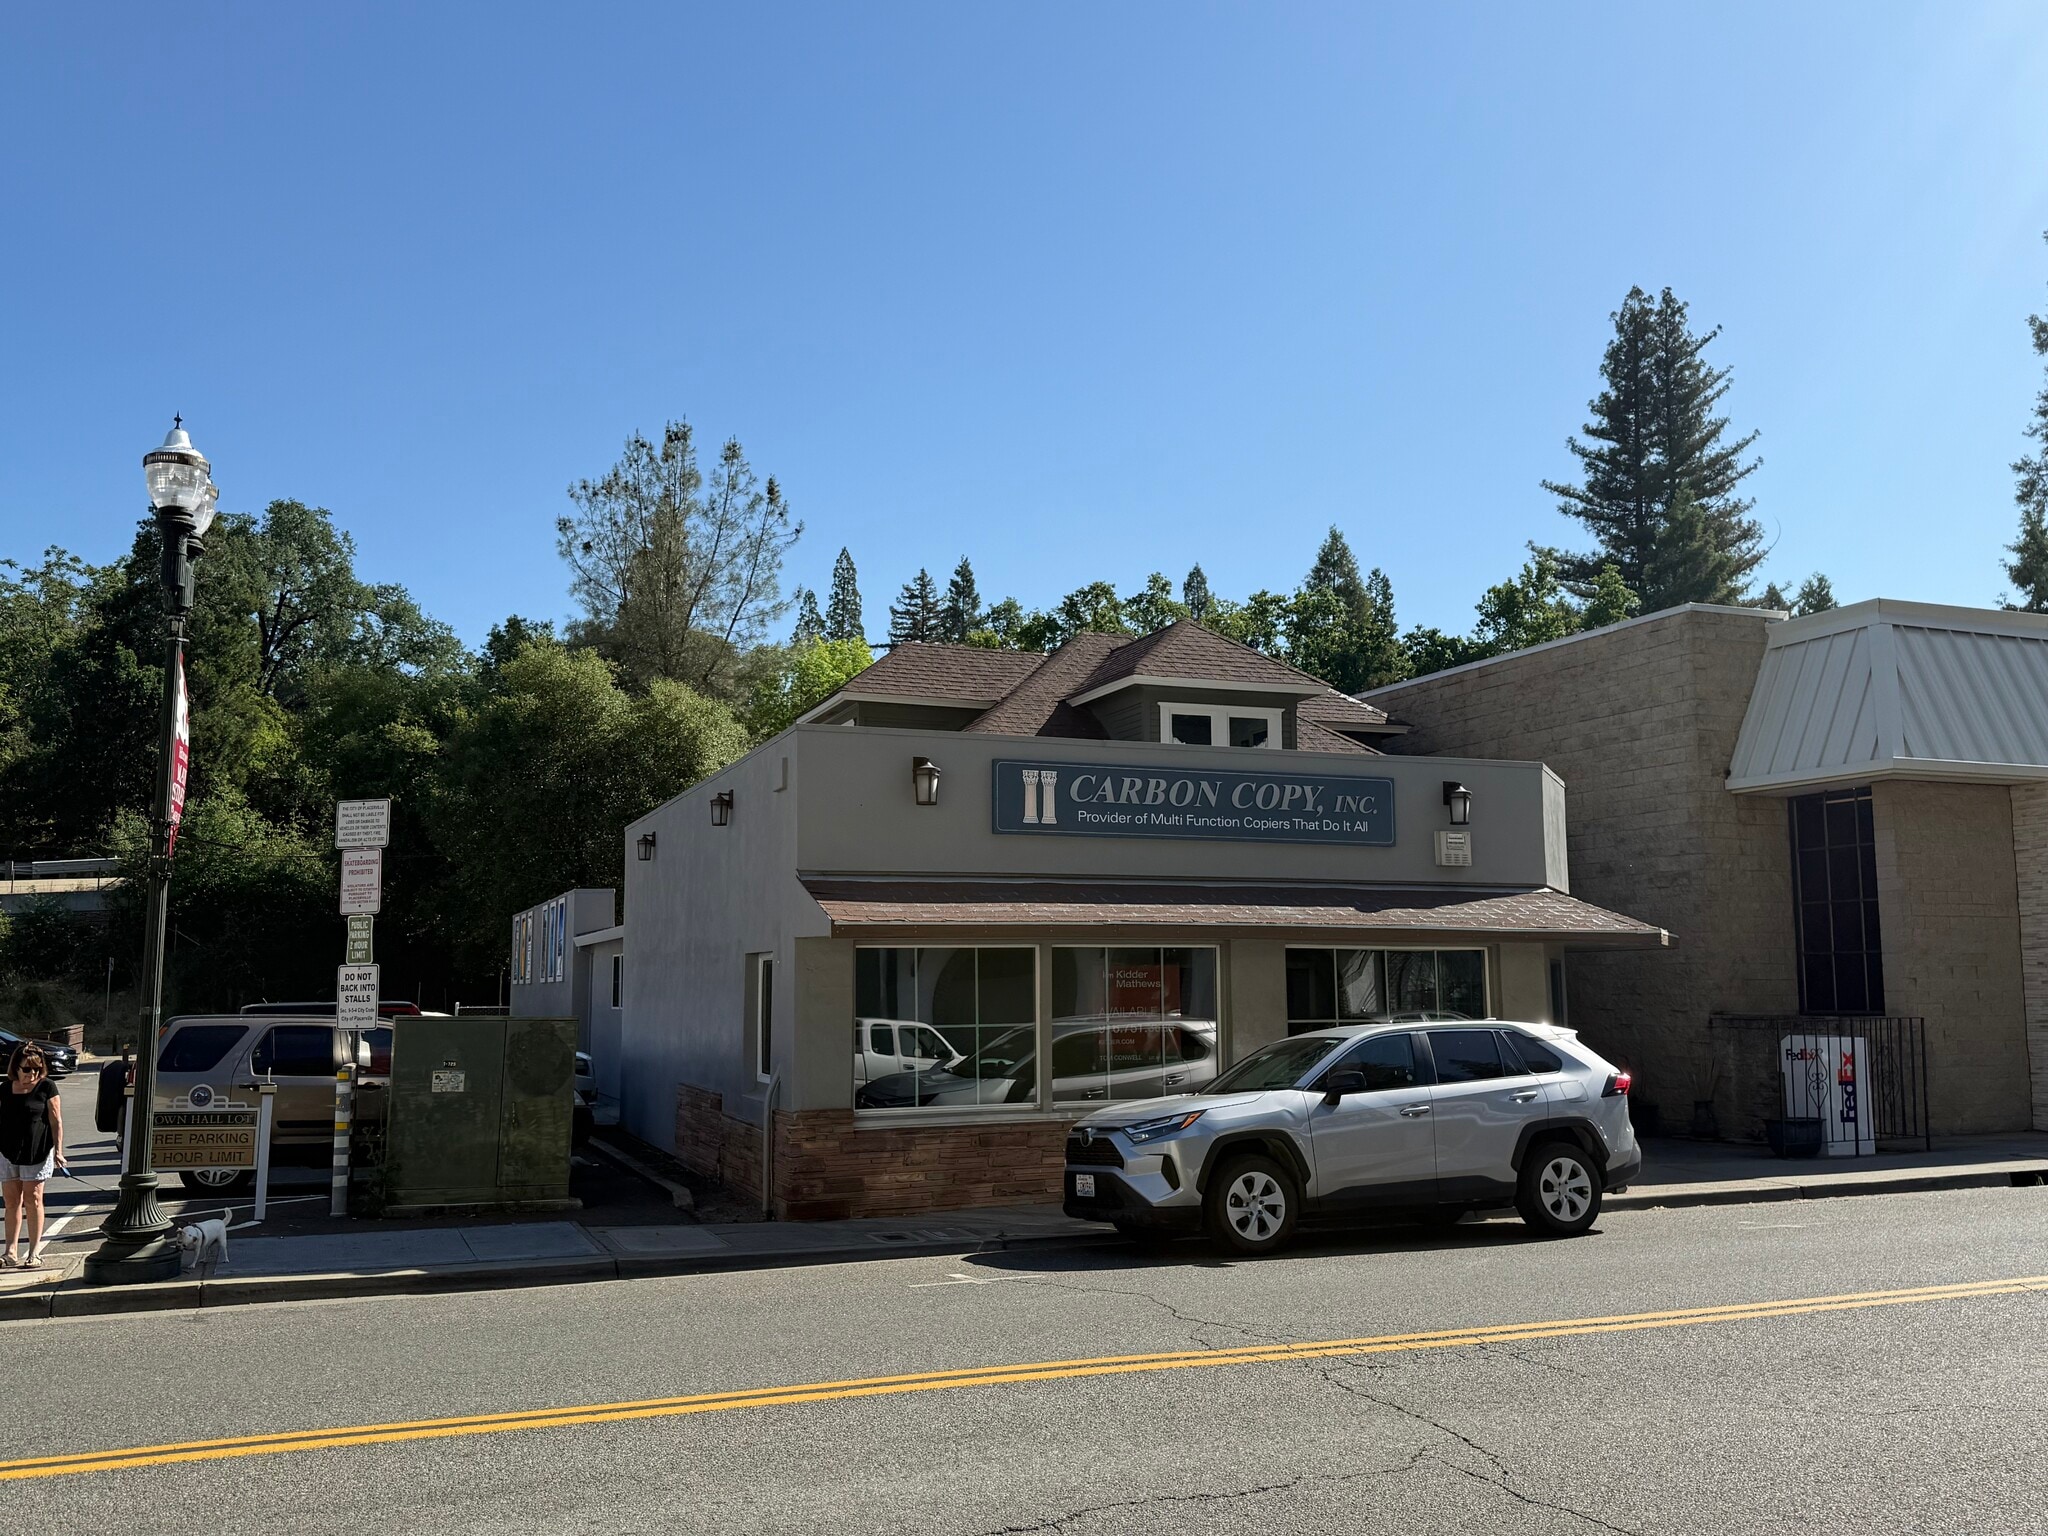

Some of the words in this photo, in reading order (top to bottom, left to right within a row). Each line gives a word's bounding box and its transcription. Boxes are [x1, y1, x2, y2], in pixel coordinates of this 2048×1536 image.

[1069, 774, 1222, 807] CARBON
[1231, 782, 1324, 817] COPY,
[1334, 796, 1378, 814] INC.
[1078, 810, 1132, 824] Provider
[1135, 813, 1148, 825] of
[1151, 814, 1183, 826] Multi
[1186, 815, 1240, 827] Function
[1244, 817, 1290, 830] Copiers
[1292, 818, 1319, 830] That
[1323, 820, 1339, 831] Do
[1343, 821, 1350, 832] It
[1354, 821, 1368, 832] All
[351, 921, 368, 929] PUBLIC
[350, 930, 369, 938] PARKING
[350, 941, 353, 949] 2
[354, 941, 368, 949] HOUR
[352, 951, 366, 959] LIMIT
[345, 973, 355, 981] DO
[1116, 970, 1148, 979] Kidder
[341, 984, 358, 992] BACK
[1116, 980, 1160, 988] Mathews
[345, 995, 370, 1003] STALLS
[1786, 1049, 1816, 1060] FedEx
[1838, 1051, 1856, 1123] FedEx
[155, 1115, 187, 1124] OWN
[191, 1115, 224, 1124] HALL
[228, 1114, 252, 1124] LOT
[189, 1133, 249, 1144] PARKING
[163, 1152, 203, 1163] HOUR
[209, 1151, 245, 1162] LIMIT
